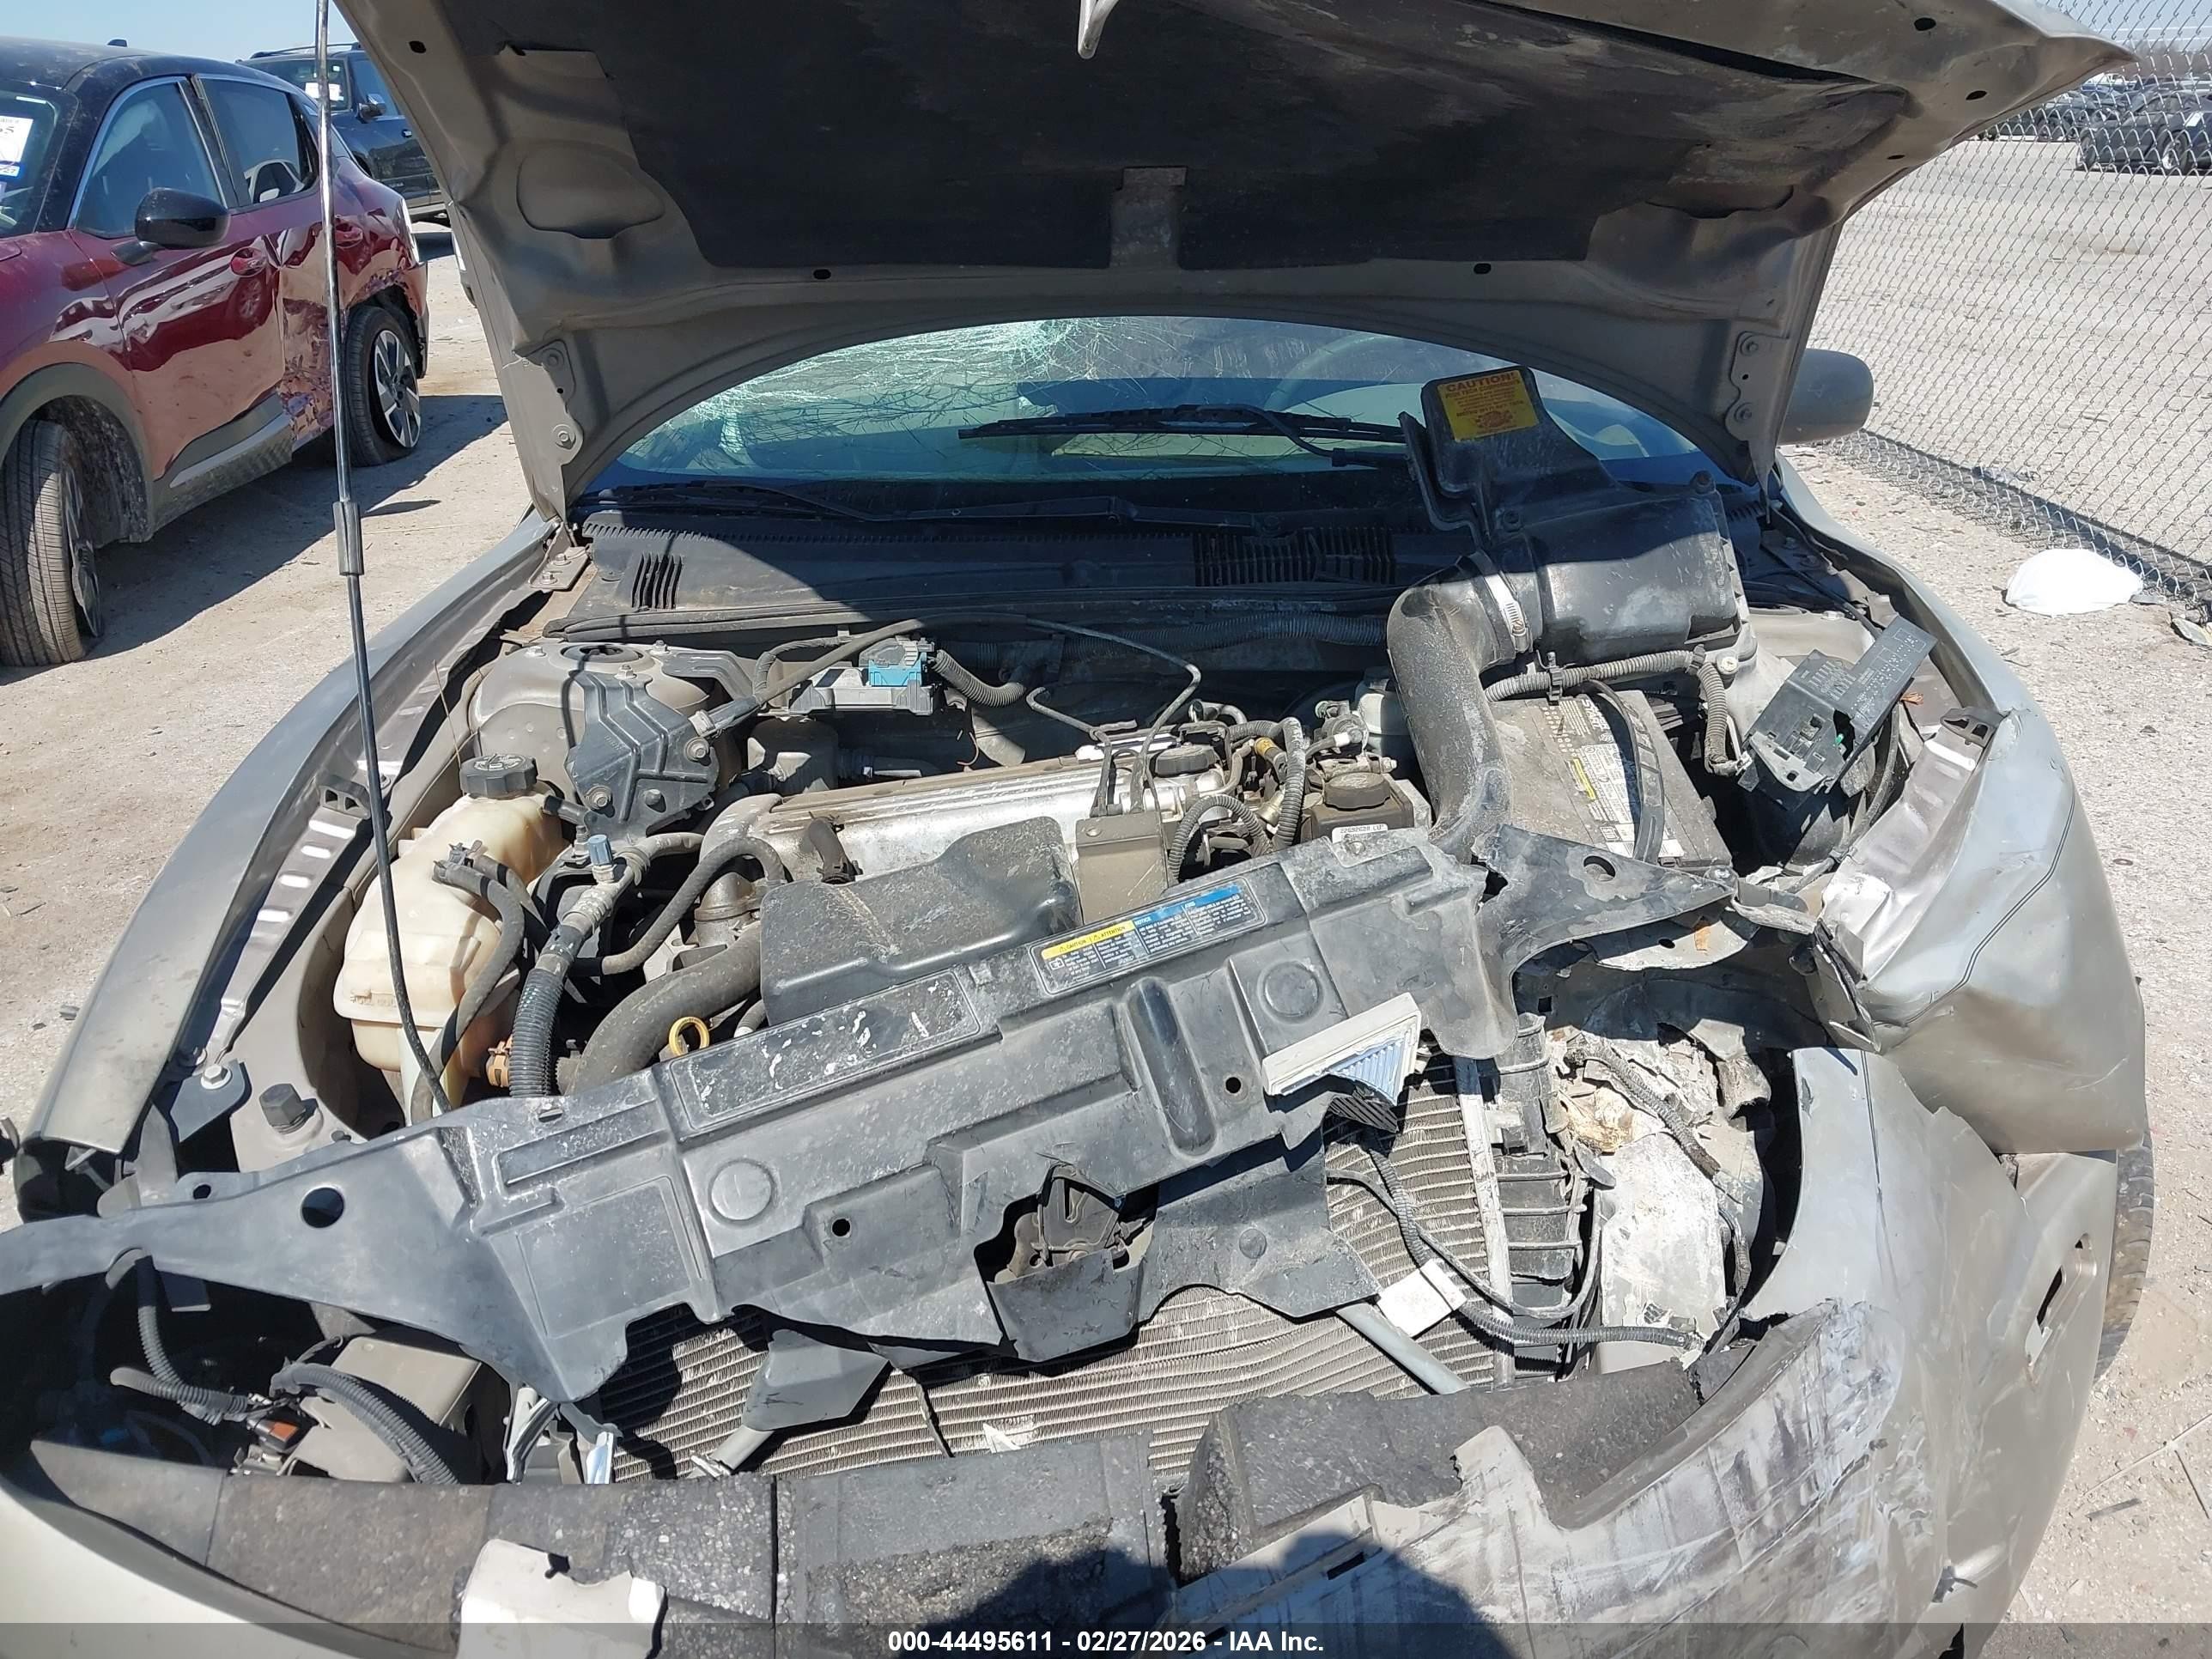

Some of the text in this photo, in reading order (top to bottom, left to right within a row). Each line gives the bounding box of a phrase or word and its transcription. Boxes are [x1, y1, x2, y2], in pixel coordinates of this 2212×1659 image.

[1446, 372, 1515, 392] CAUTION!
[1581, 699, 1602, 732] START
[1066, 927, 1126, 950] CAUTION ATTENTION
